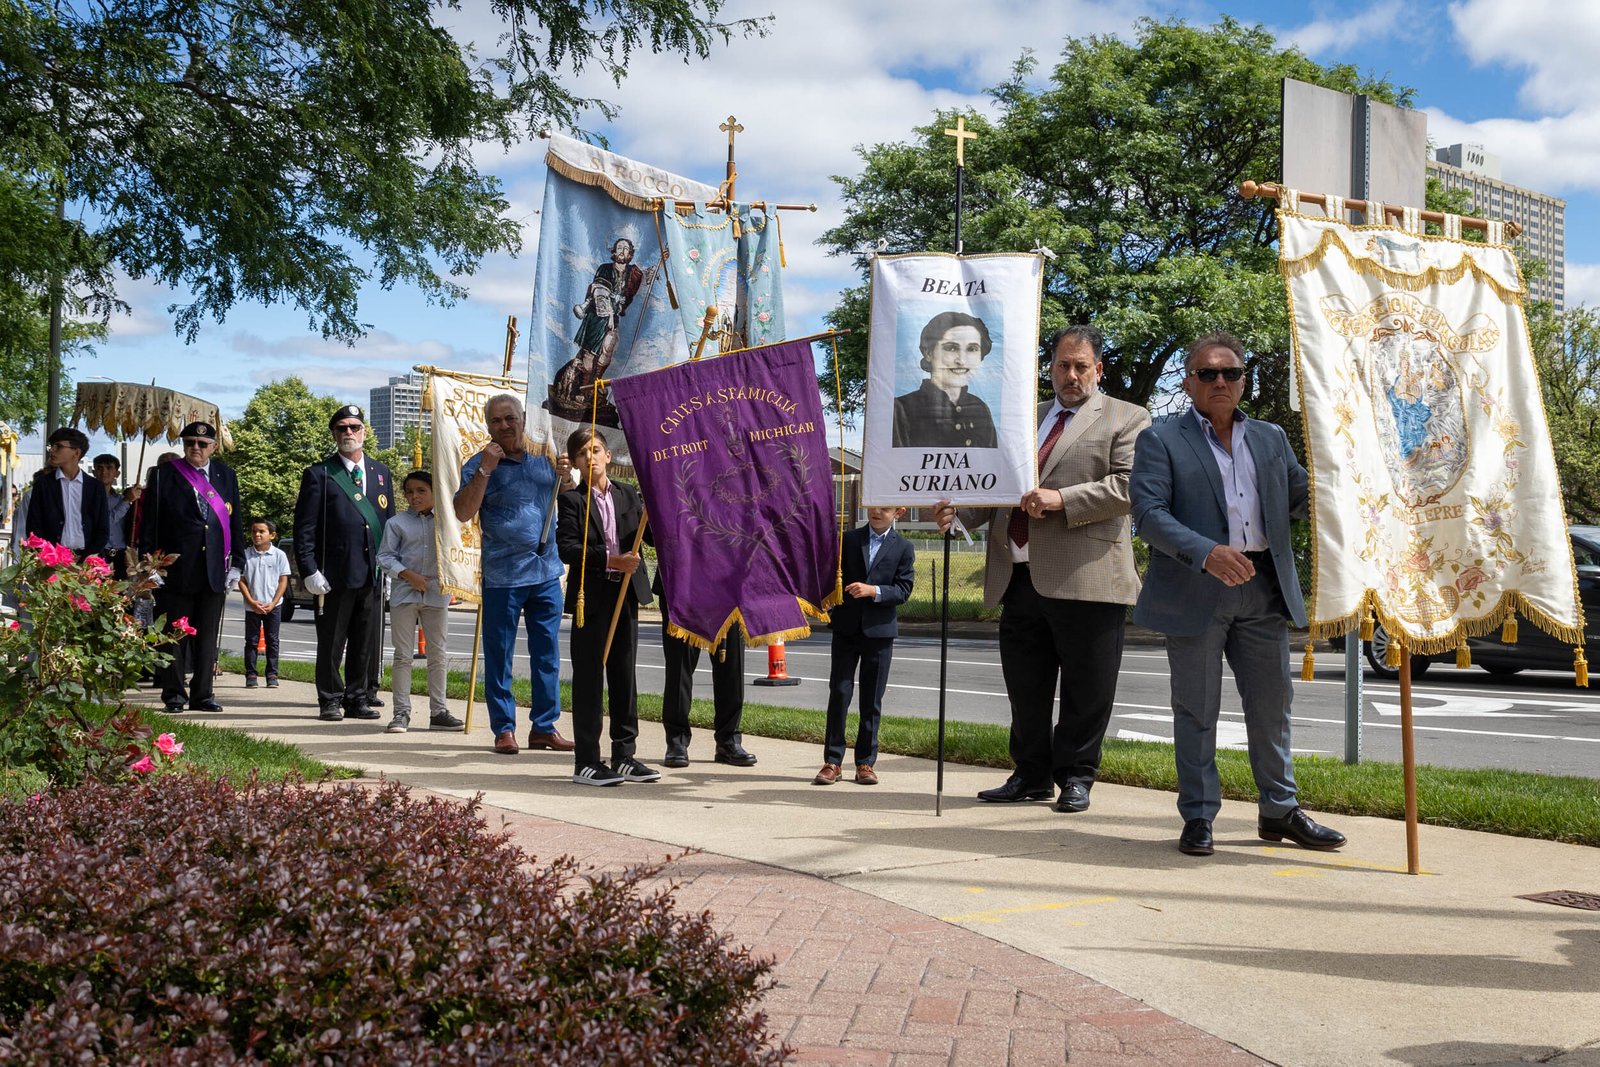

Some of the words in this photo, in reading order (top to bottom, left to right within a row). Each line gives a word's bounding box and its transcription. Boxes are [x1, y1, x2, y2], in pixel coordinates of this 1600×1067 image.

[614, 166, 684, 196] ROCCO
[921, 277, 987, 297] BEATA
[653, 439, 709, 462] DETROIT
[920, 452, 970, 470] PINA
[899, 473, 997, 492] SURIANO
